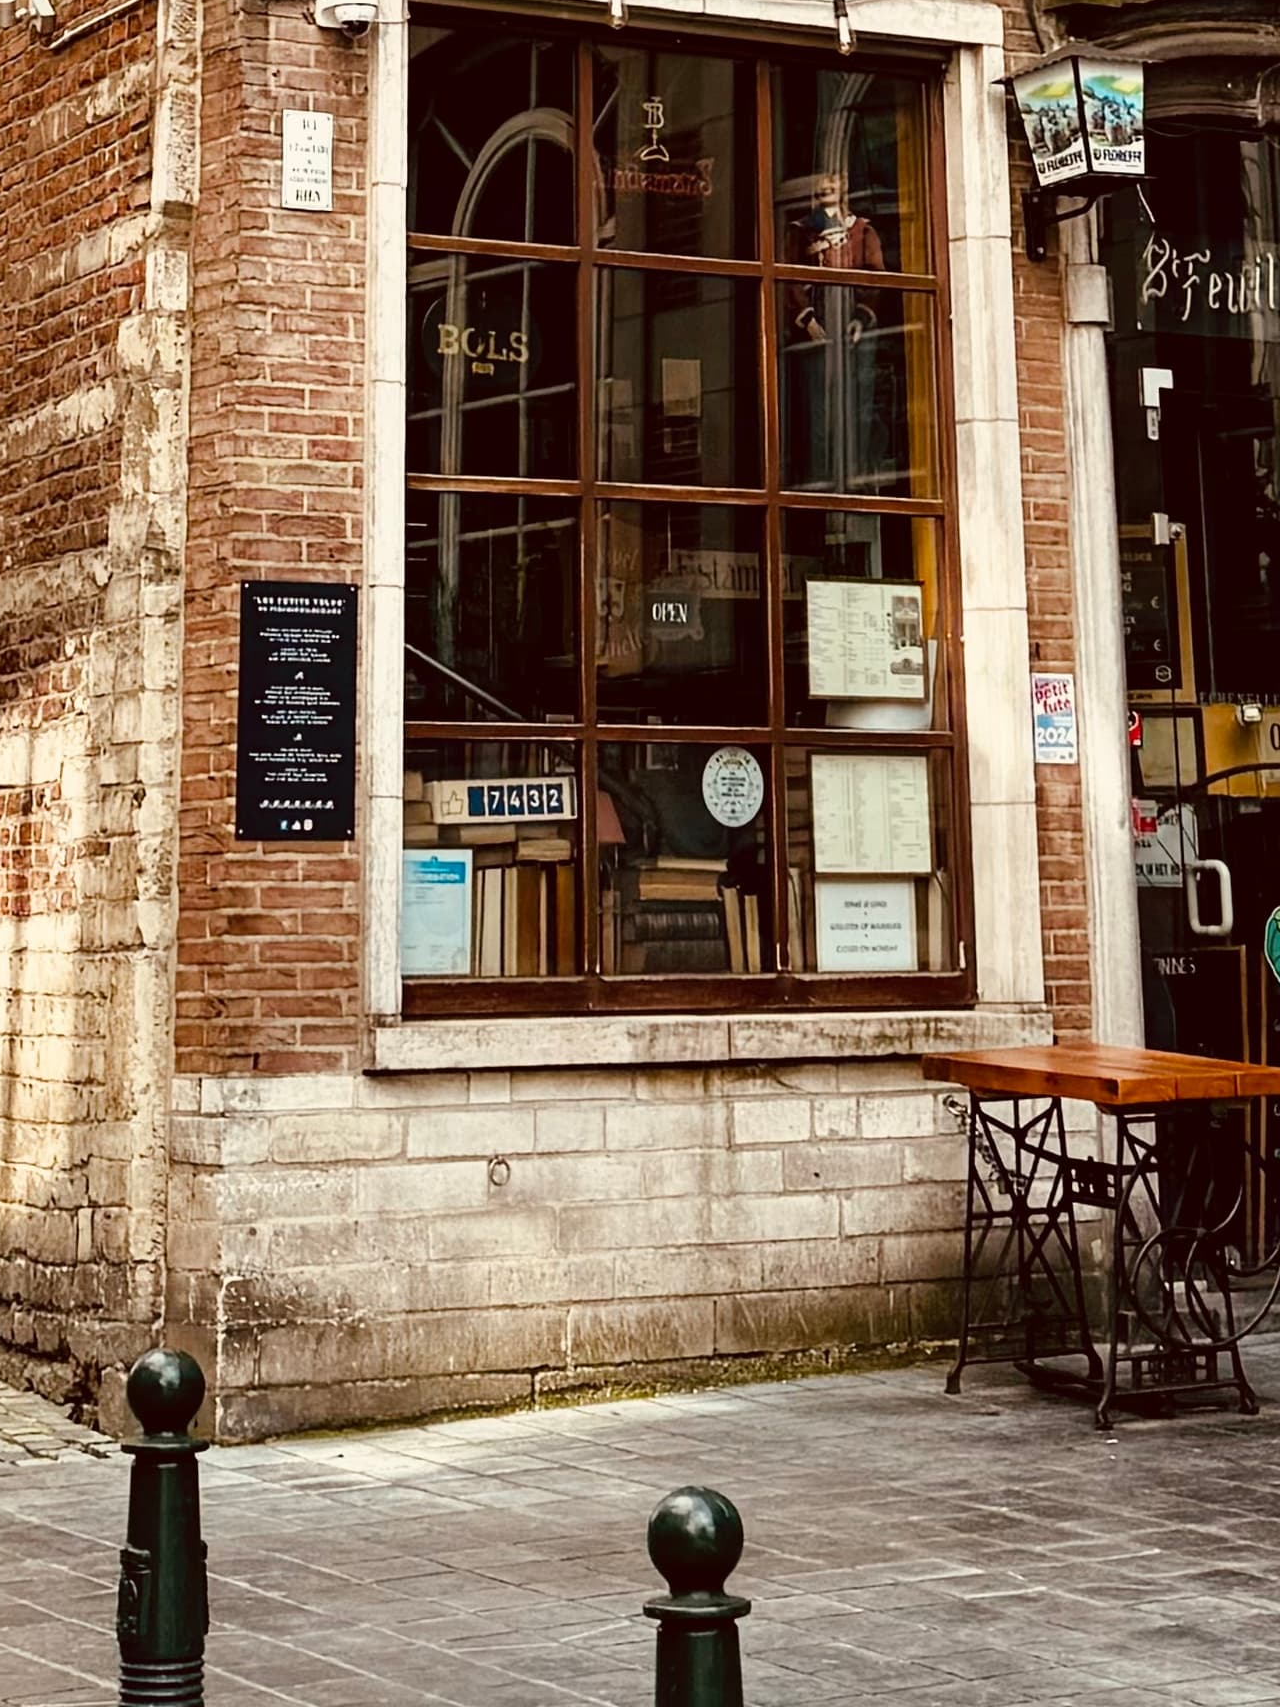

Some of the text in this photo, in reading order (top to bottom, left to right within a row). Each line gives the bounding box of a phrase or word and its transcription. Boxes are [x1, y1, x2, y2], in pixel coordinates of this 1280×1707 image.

[437, 323, 530, 364] BOLS
[651, 601, 688, 623] OPEN
[489, 789, 560, 809] 7432
